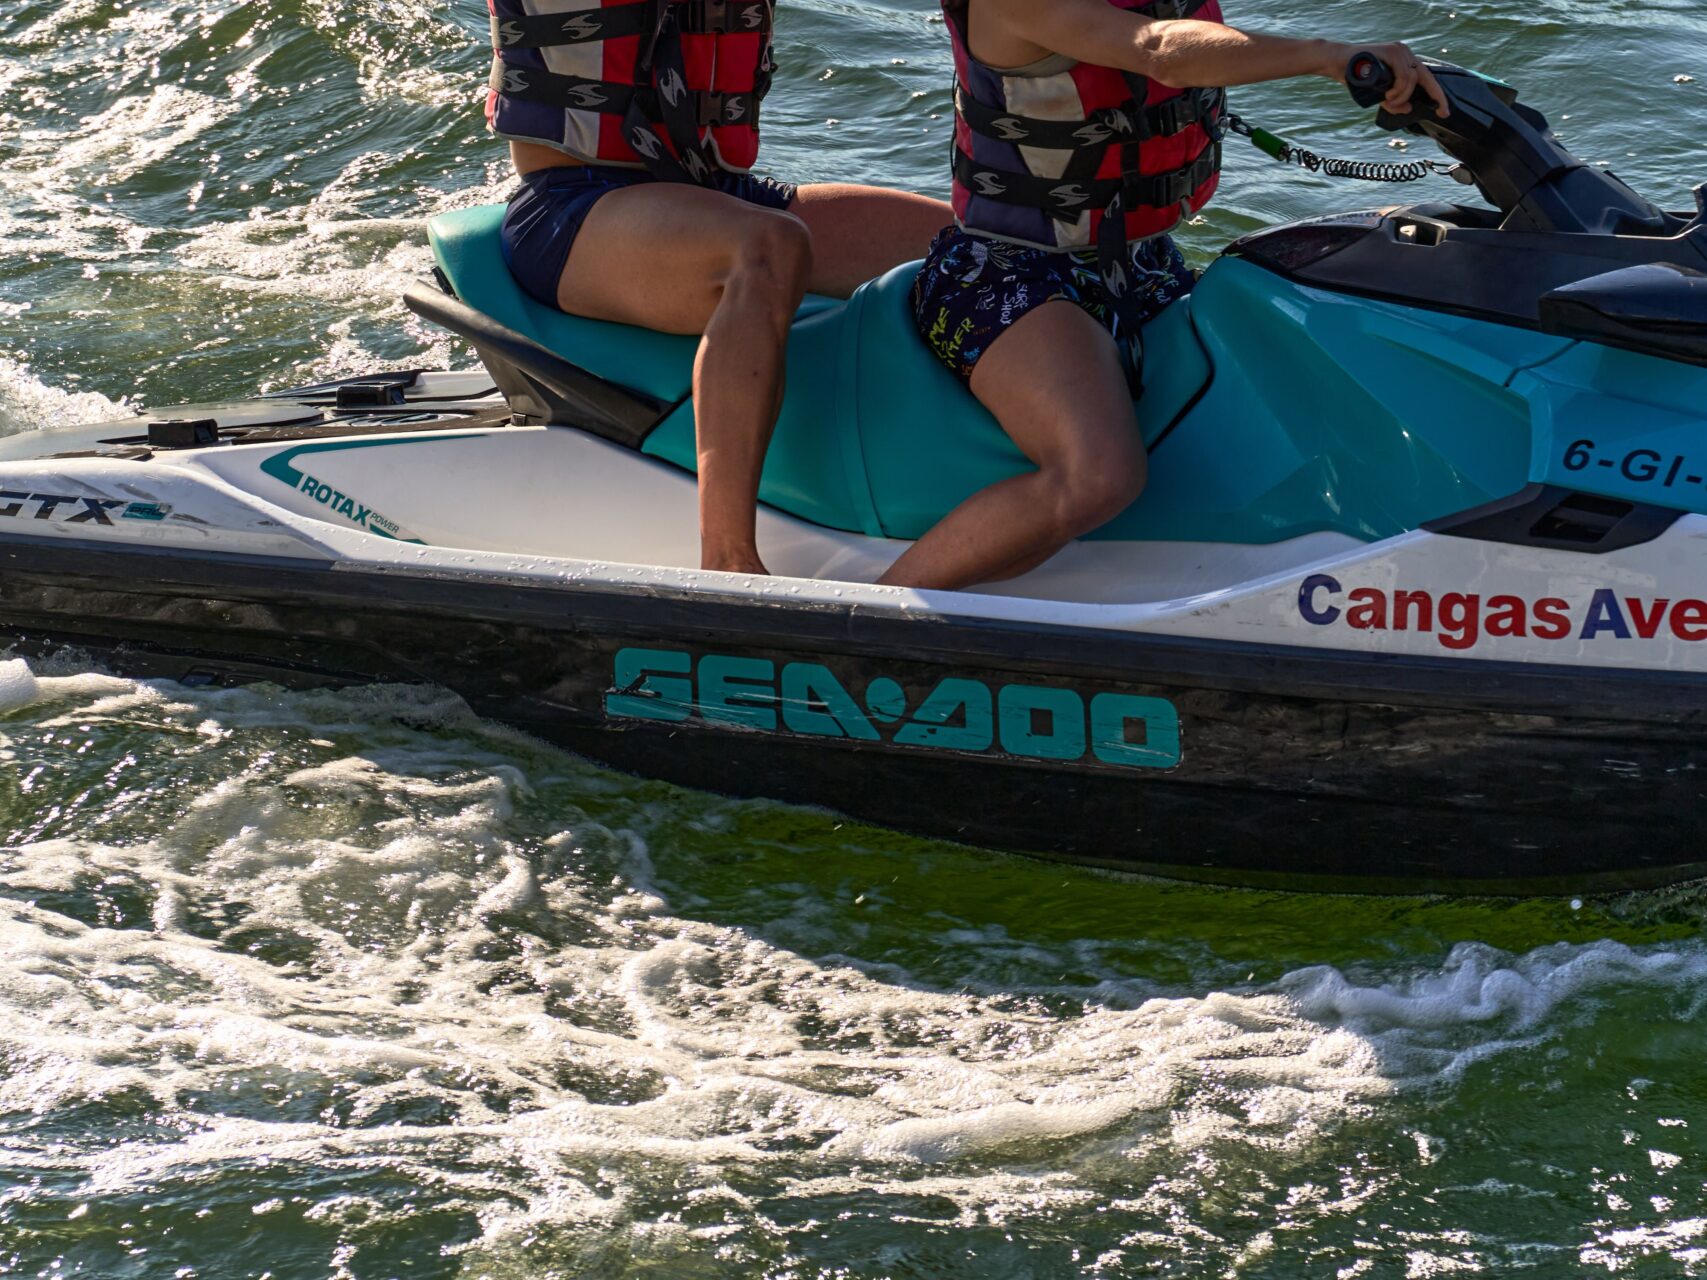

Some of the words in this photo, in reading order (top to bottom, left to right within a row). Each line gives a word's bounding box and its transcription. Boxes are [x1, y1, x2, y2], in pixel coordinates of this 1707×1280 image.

[1563, 439, 1707, 488] 6-GI-
[0, 491, 128, 526] GTX
[300, 476, 372, 527] ROTAX
[369, 512, 400, 534] POWER
